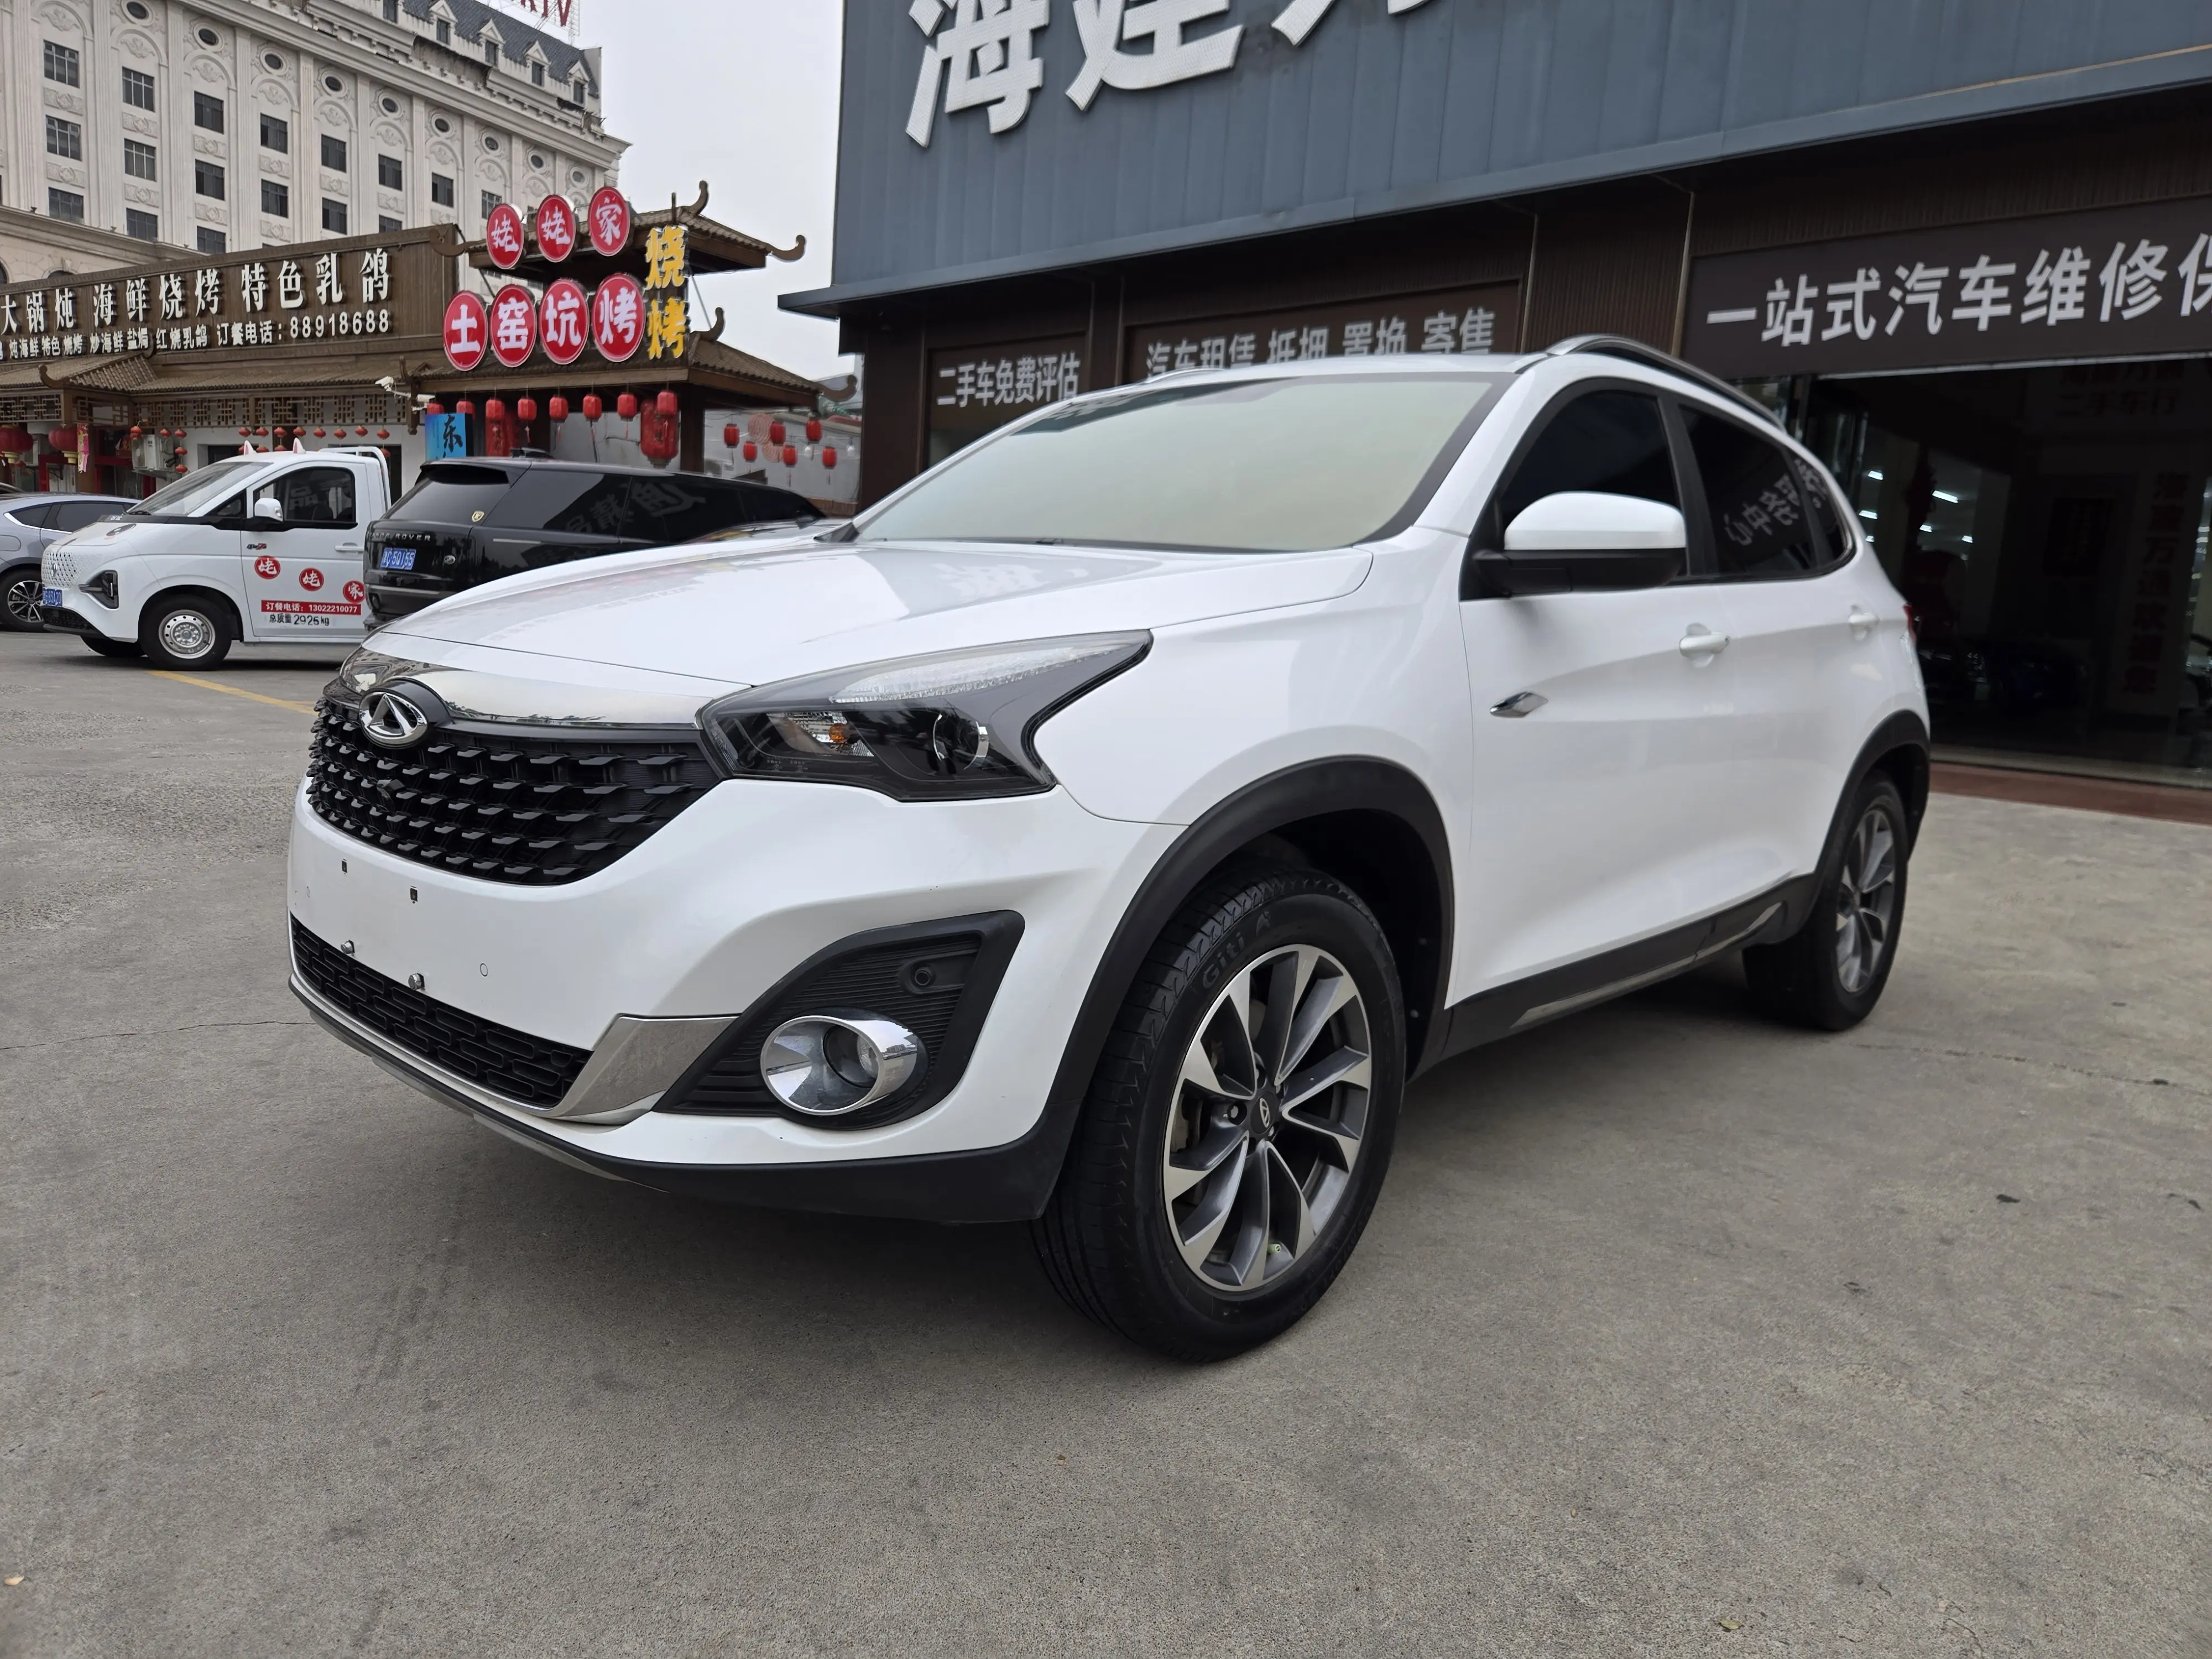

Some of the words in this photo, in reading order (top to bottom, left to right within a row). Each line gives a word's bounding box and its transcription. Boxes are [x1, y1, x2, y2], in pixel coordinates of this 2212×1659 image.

[491, 196, 624, 252] 姥姥家
[1, 288, 74, 335] 大锅炖
[93, 268, 222, 327] 海鲜烧烤
[241, 248, 389, 313] 特色乳鸽
[451, 287, 638, 354] 土窑坑烤
[646, 226, 688, 359] 烧烤
[937, 349, 1081, 408] 二手车免费评估
